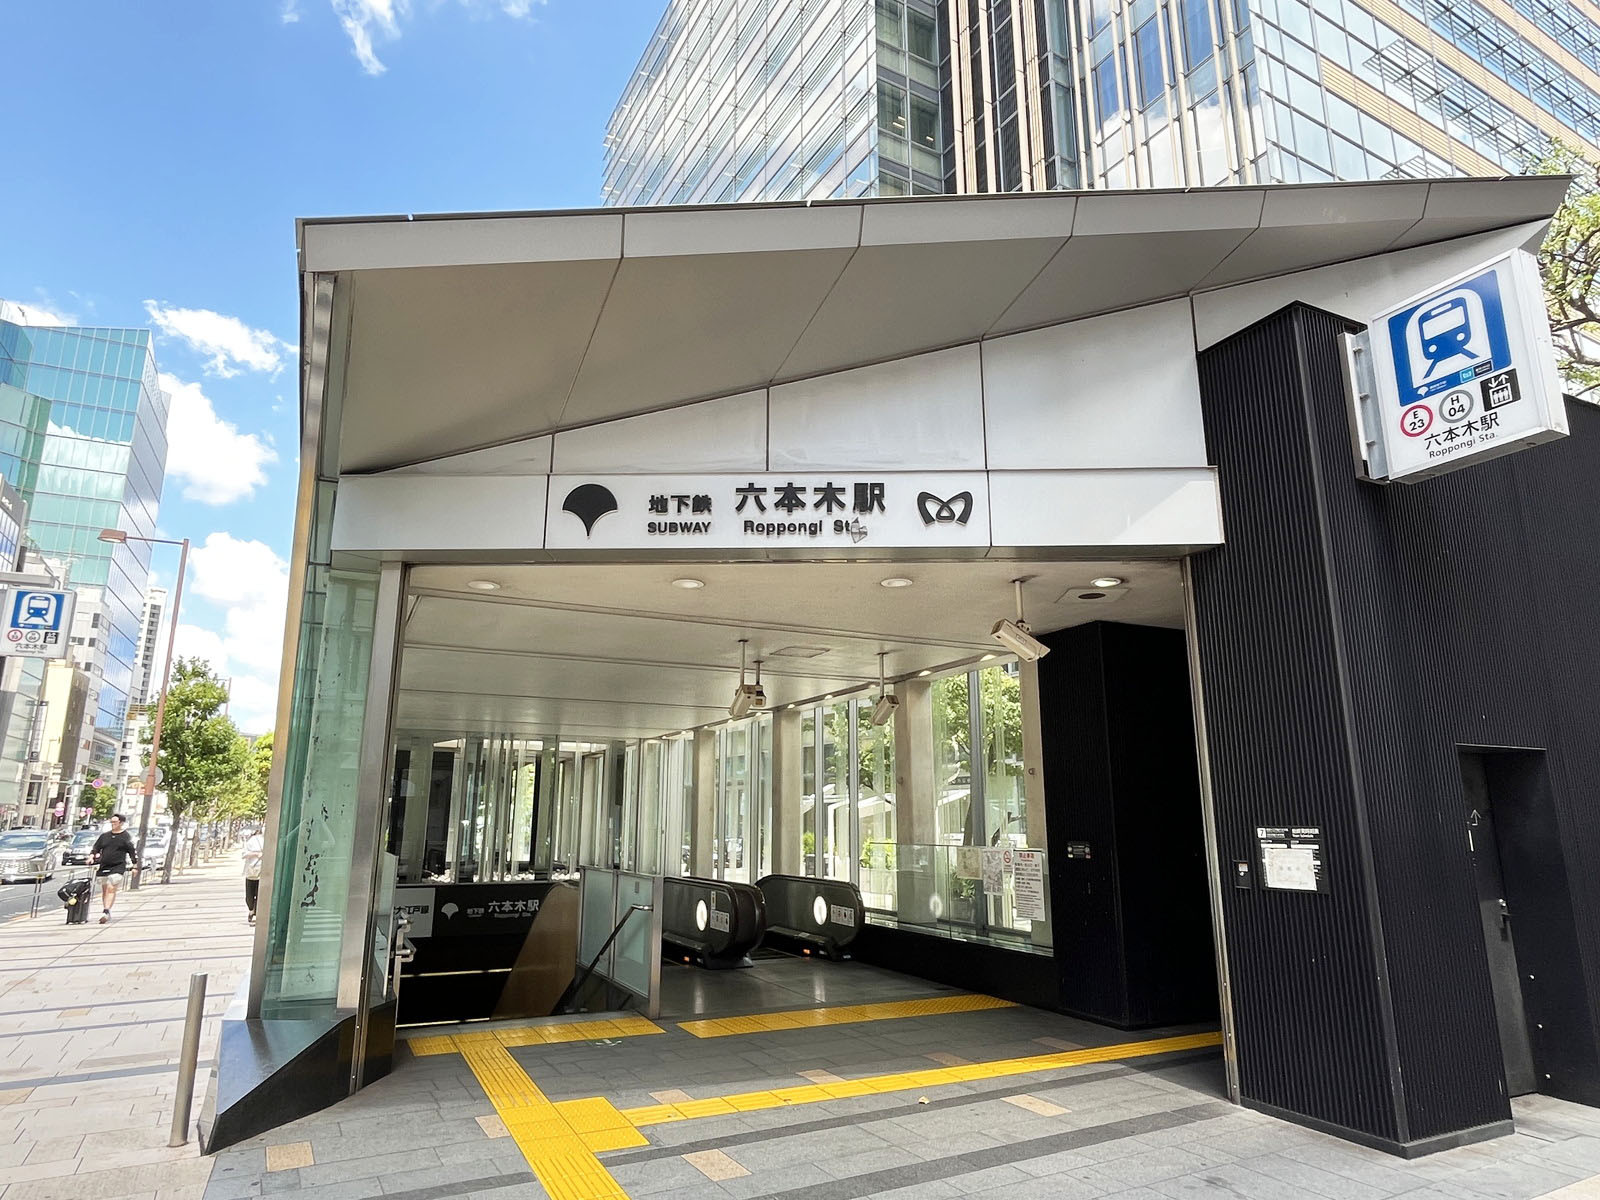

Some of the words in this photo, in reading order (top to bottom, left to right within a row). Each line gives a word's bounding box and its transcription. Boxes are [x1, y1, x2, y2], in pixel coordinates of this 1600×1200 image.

[1450, 395, 1460, 406] H
[1413, 410, 1419, 420] E
[1448, 404, 1466, 417] 04
[1409, 418, 1425, 431] 23
[1424, 412, 1500, 450] 六本木駅
[1429, 436, 1476, 458] Roppongi
[1479, 432, 1498, 442] Sta.
[648, 494, 712, 514] 地下鉄
[735, 482, 886, 513] 六本木駅
[647, 521, 712, 534] SUBWAY
[743, 519, 823, 536] Roppongi
[488, 899, 539, 913] 六本木駅
